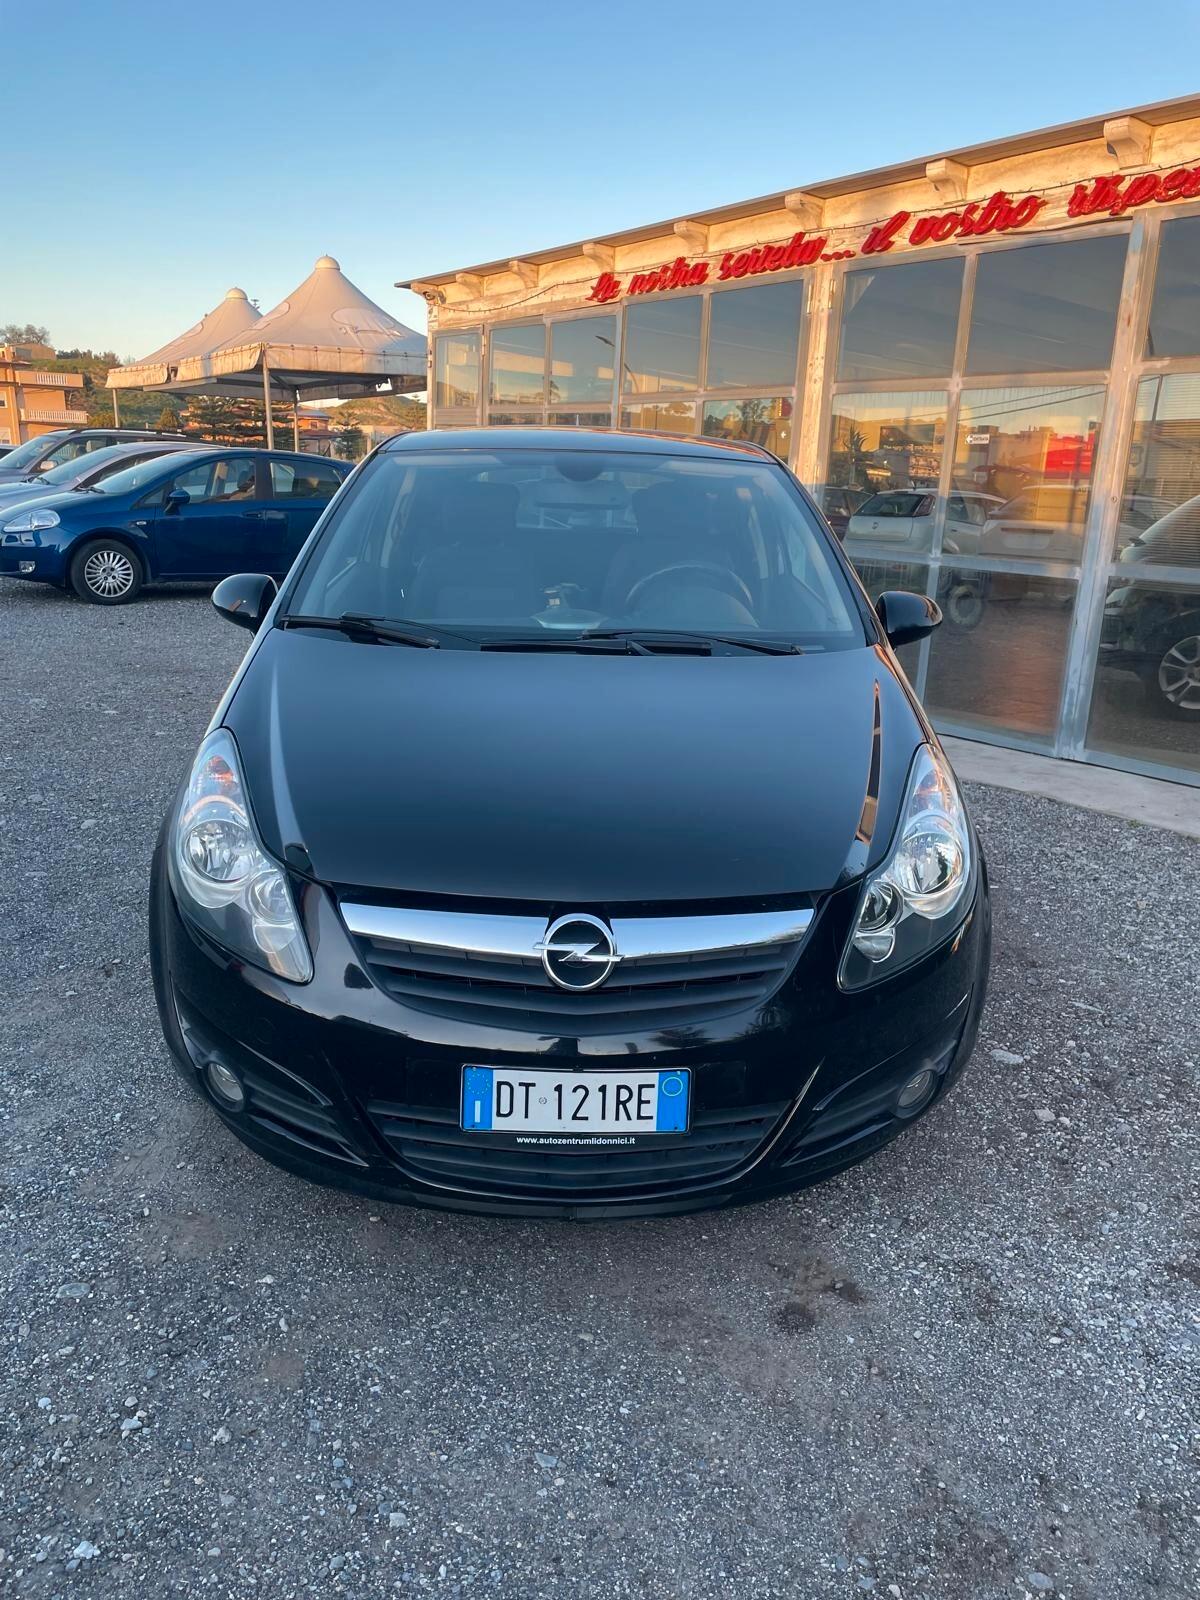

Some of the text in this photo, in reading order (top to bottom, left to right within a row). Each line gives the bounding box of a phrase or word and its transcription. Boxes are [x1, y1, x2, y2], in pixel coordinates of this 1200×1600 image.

[626, 256, 710, 296] nostra
[860, 210, 912, 254] il
[908, 190, 1050, 246] vostro
[495, 1080, 656, 1121] DT 121RE
[516, 1136, 636, 1145] www.autozentrumlidonnici.it
